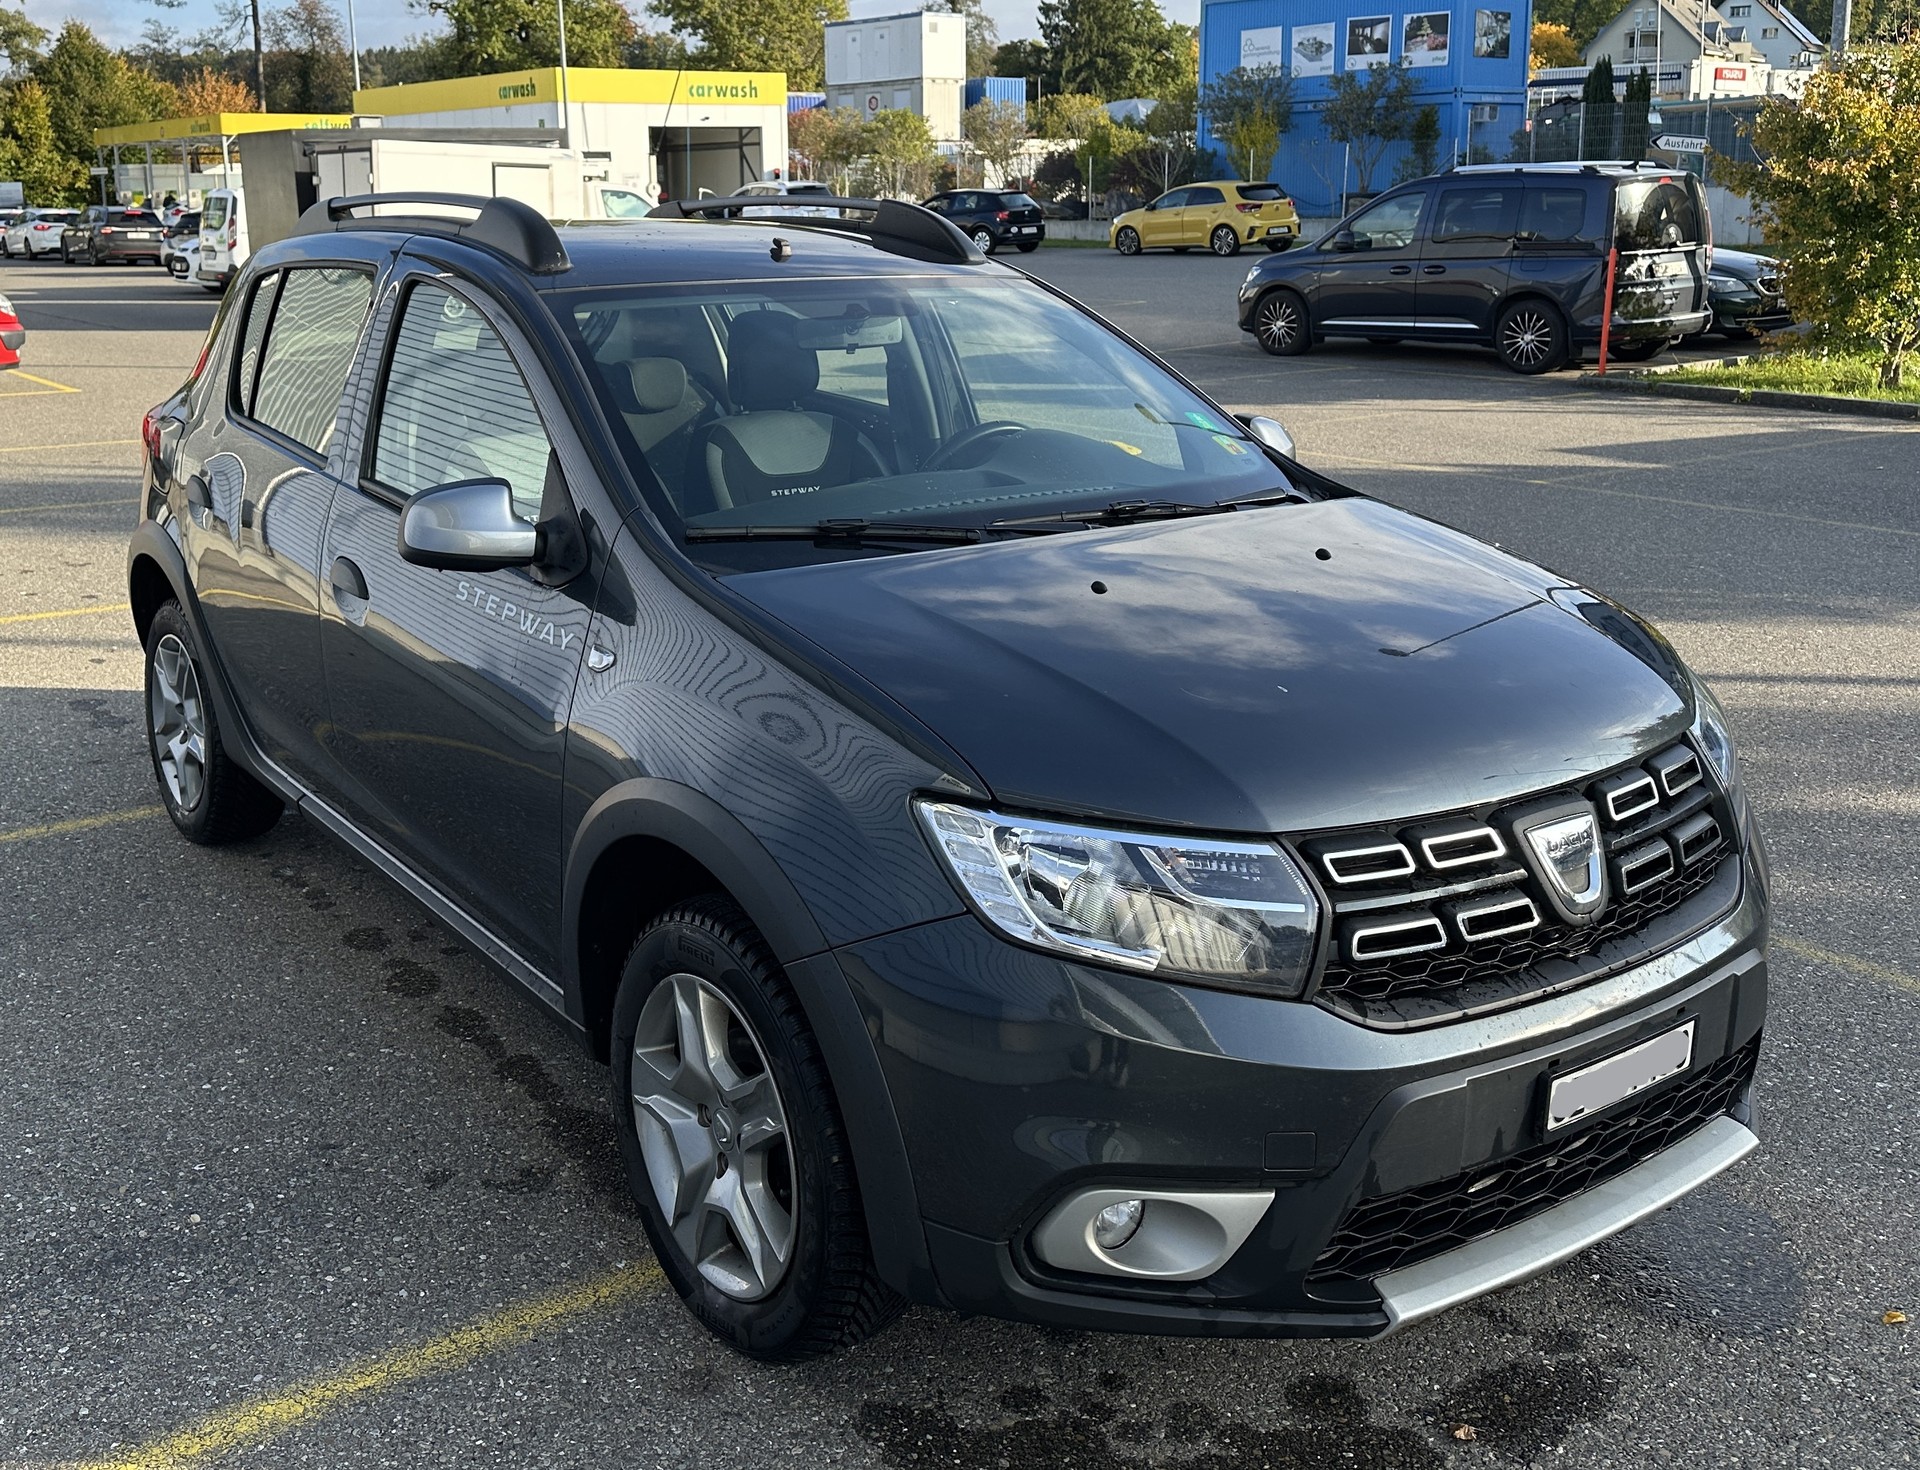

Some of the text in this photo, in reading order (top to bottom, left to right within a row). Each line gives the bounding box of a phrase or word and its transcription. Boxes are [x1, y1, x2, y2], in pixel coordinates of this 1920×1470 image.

[1722, 69, 1743, 79] ISUZU
[499, 77, 536, 99] carwash
[688, 80, 758, 98] carwash
[1664, 138, 1703, 150] Ausfahrt
[771, 486, 820, 497] STEPWAY
[455, 581, 574, 650] STEPWAY
[1546, 828, 1594, 854] DACIA
[678, 935, 715, 967] PIRELLI
